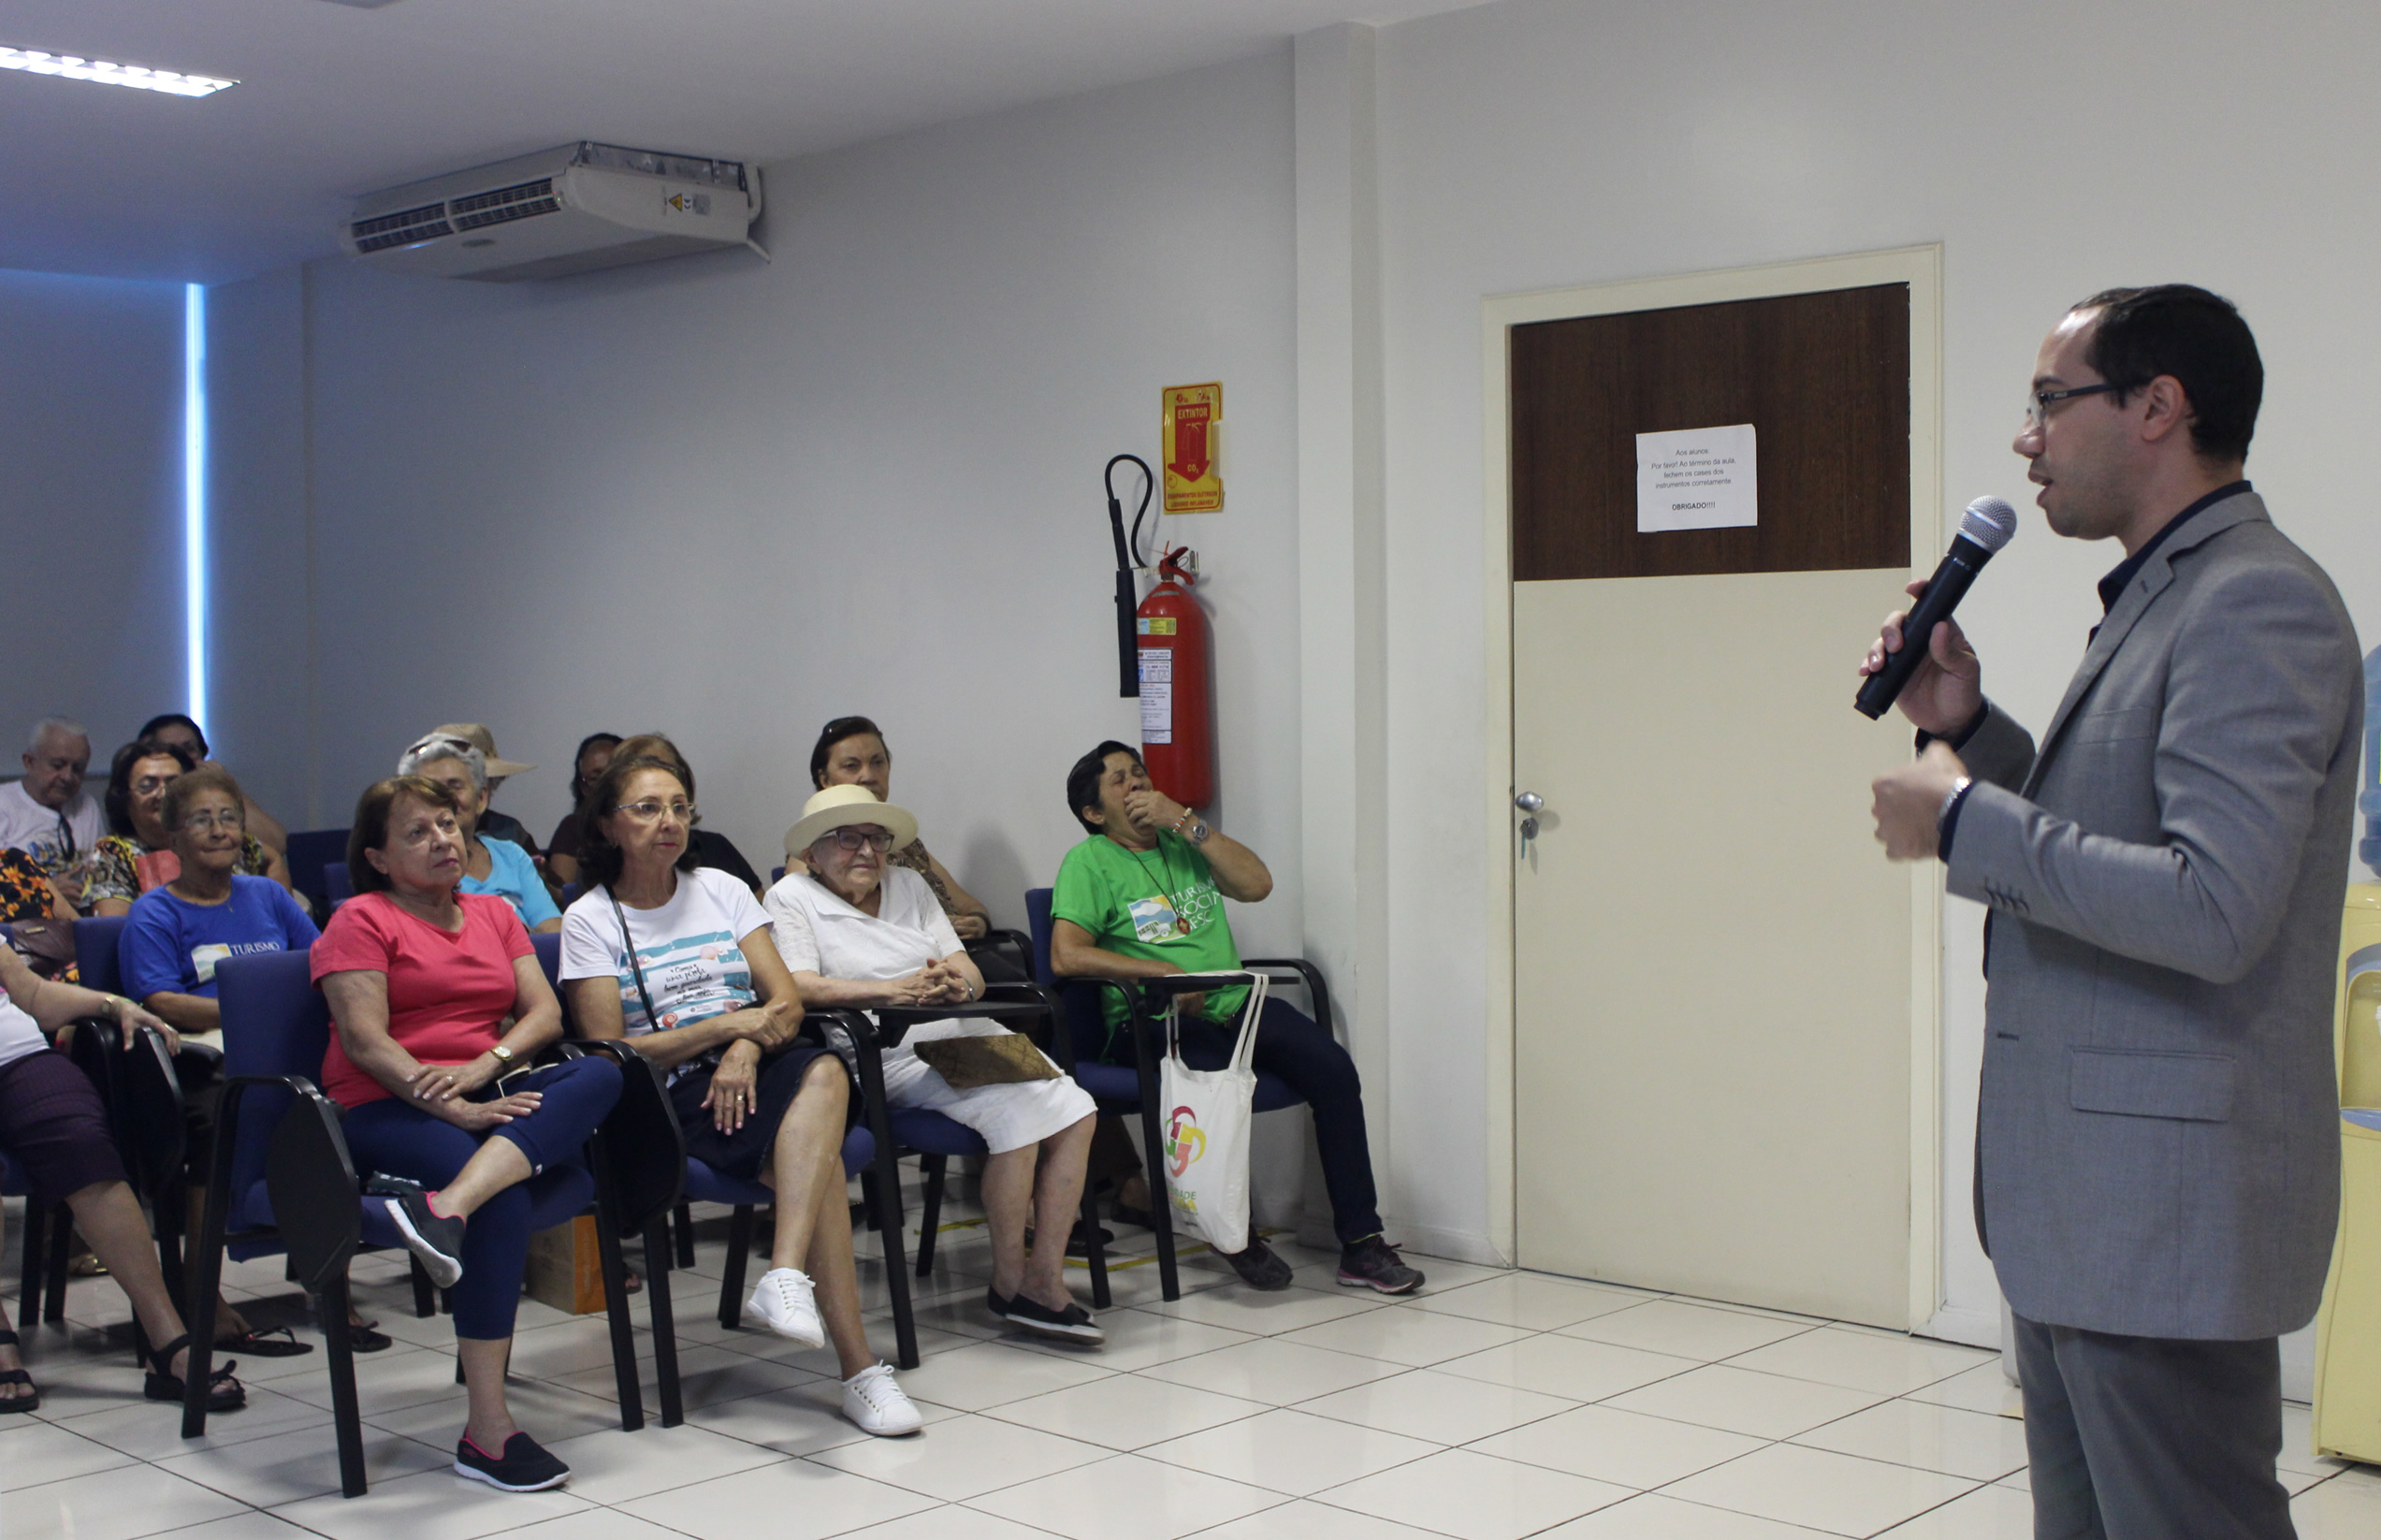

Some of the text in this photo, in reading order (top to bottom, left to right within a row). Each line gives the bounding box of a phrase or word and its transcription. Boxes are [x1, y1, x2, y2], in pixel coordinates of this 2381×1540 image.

[1178, 407, 1208, 419] EXTINTOR
[1169, 875, 1214, 903] TURISM
[1175, 891, 1221, 919] SOCIA
[1188, 909, 1215, 931] ESC
[230, 941, 280, 955] TURISMO
